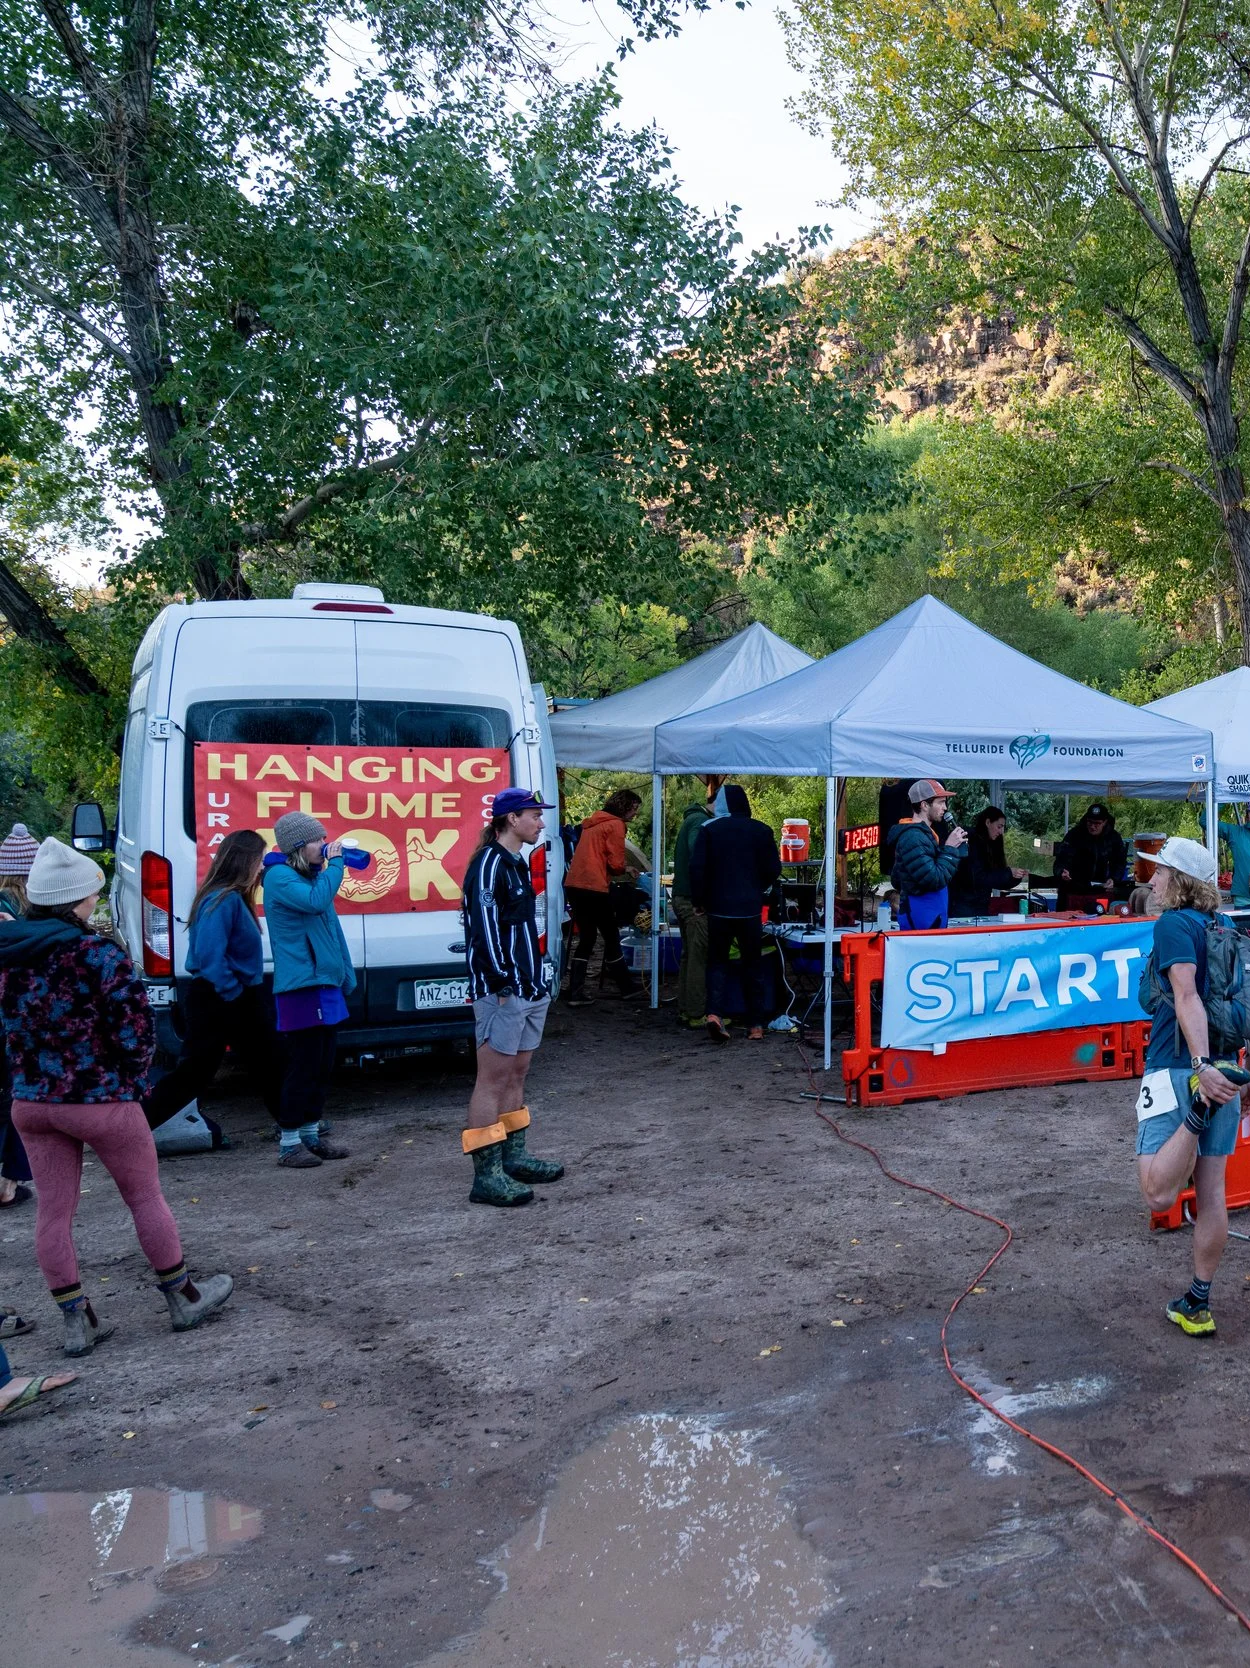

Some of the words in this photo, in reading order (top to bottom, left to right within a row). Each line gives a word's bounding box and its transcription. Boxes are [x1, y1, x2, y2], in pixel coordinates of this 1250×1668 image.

[945, 743, 1004, 754] TELLURIDE
[1053, 746, 1124, 757] FOUNDATION
[207, 753, 501, 783] HANGING
[1227, 774, 1250, 785] QUIK
[256, 791, 461, 820] FLUME
[905, 948, 1141, 1023] START
[1141, 1086, 1154, 1109] 3
